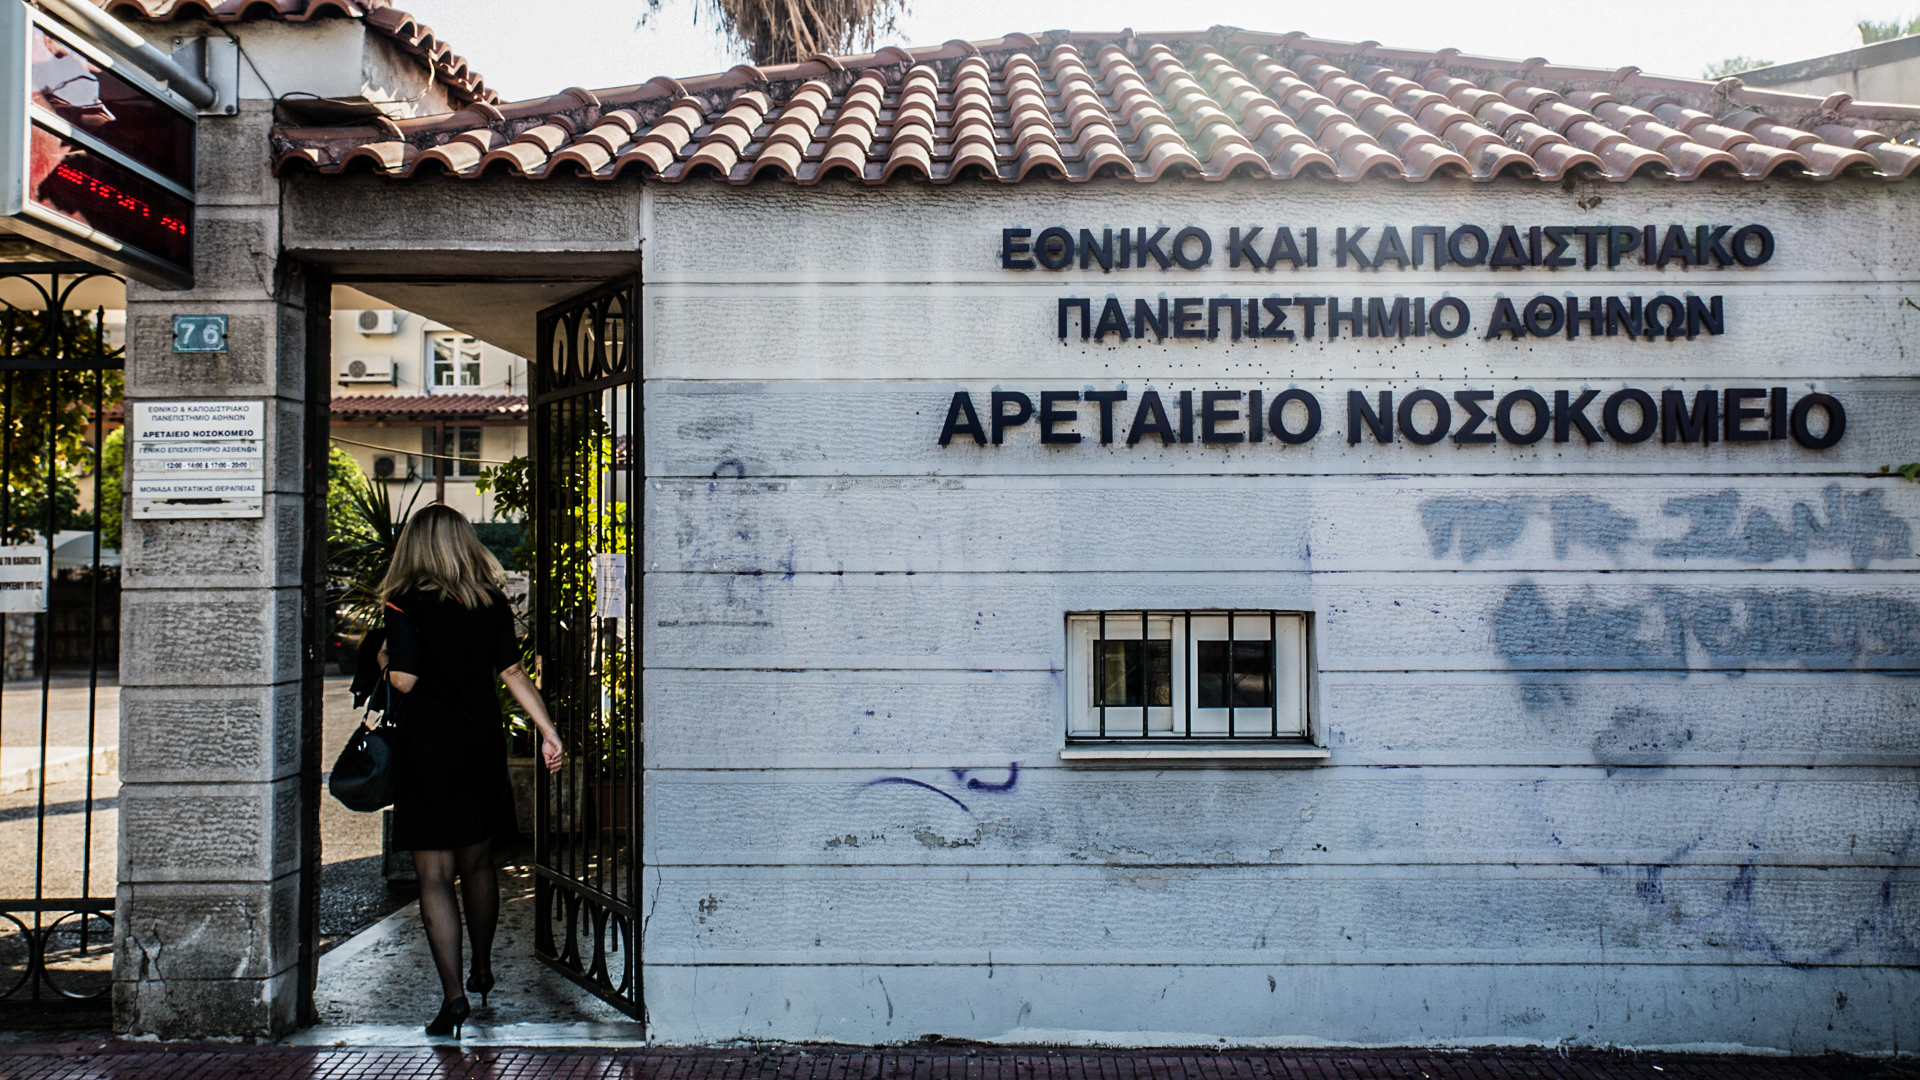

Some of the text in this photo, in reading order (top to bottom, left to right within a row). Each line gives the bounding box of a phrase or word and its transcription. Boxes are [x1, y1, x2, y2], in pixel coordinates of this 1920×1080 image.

[1002, 224, 1775, 270] ΕΘΝΙΚΟ ΚΑΙ ΚΑΠΟΔΙΣΤΡΙΑΚΟ
[180, 323, 219, 345] 76
[1058, 295, 1724, 340] ΠΑΝΕΠΙΣΤΗΜΙΟ ΑΘΗΝΩΝ
[142, 429, 254, 438] ΑΡΕΤΑΙΕΙΟ ΝΟΣΟΚΟΜΕΙΟ
[938, 387, 1847, 449] ΑΡΕΤΑΙΕΙΟ ΝΟΣΟΚΟΜΕΙΟ
